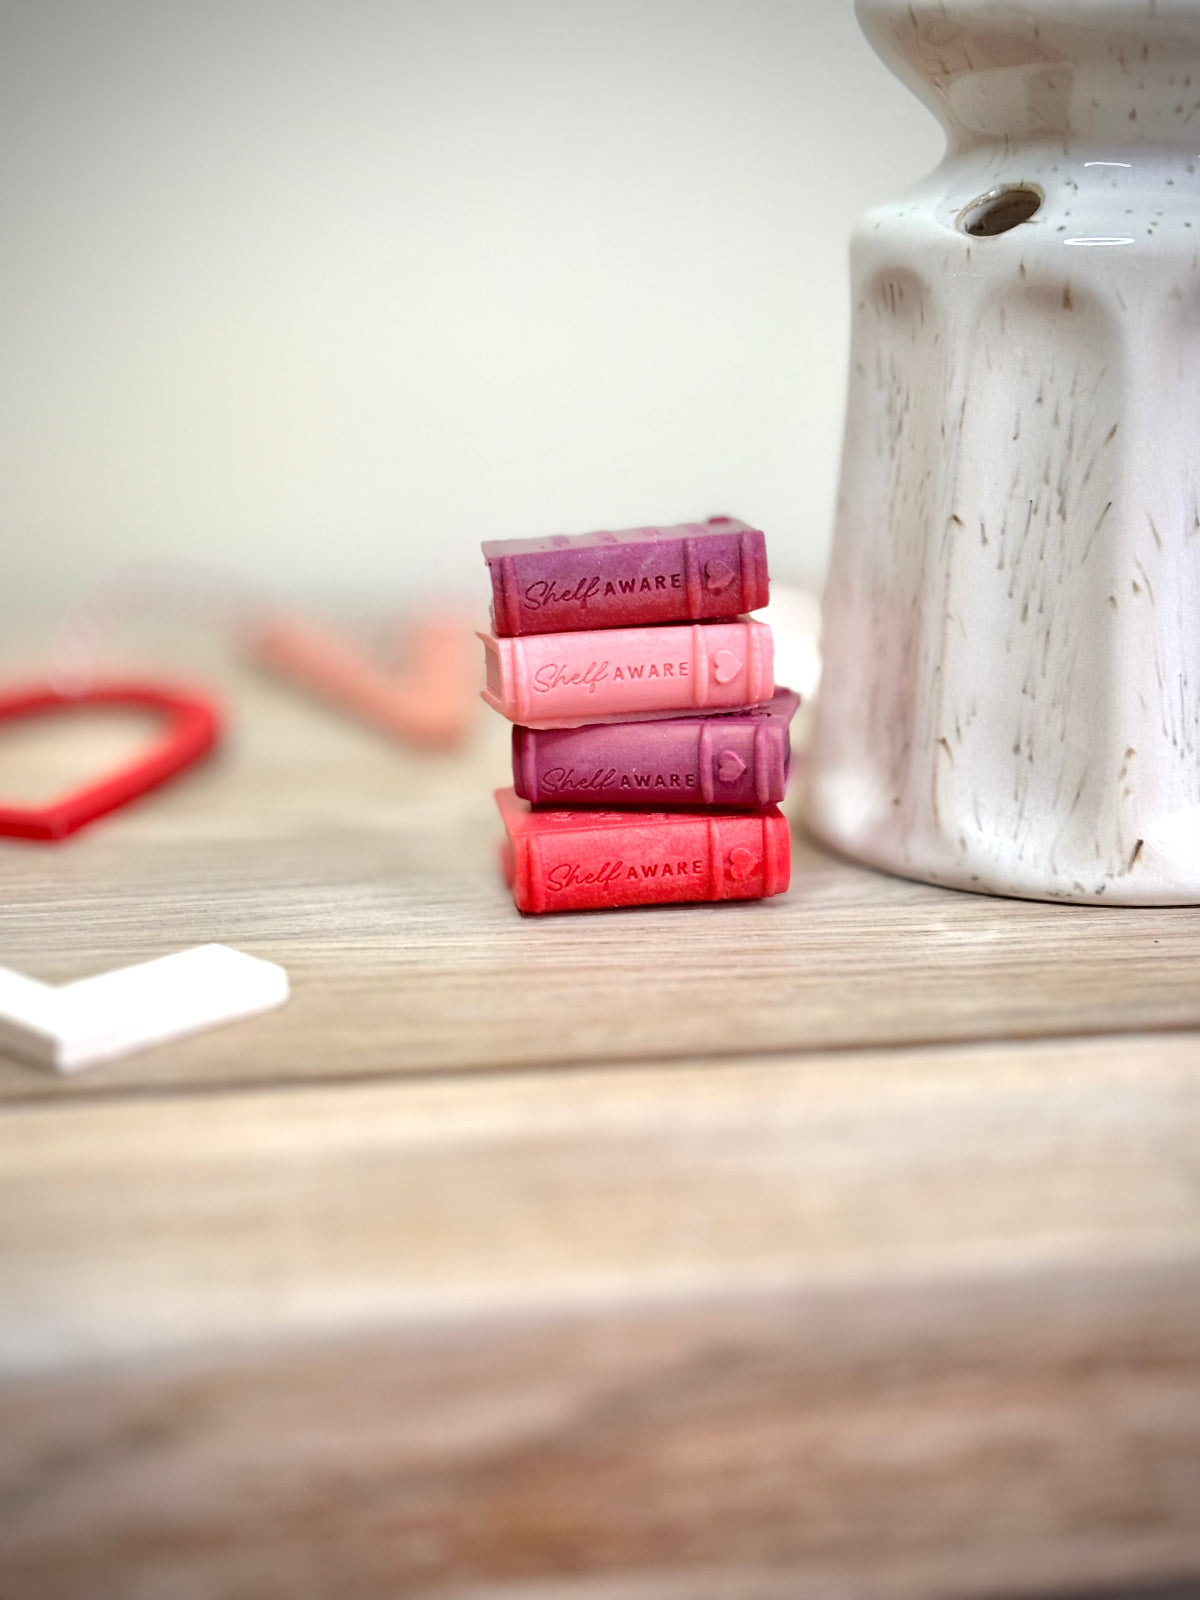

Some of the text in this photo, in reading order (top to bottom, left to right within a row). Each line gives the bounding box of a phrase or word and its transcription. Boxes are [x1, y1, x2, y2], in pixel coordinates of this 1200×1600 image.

[524, 573, 682, 611] Shelf AWARE
[533, 660, 690, 694] Shelf AWARE
[541, 767, 699, 794] Shelf AWARE
[546, 860, 705, 893] Shelf AWARE
